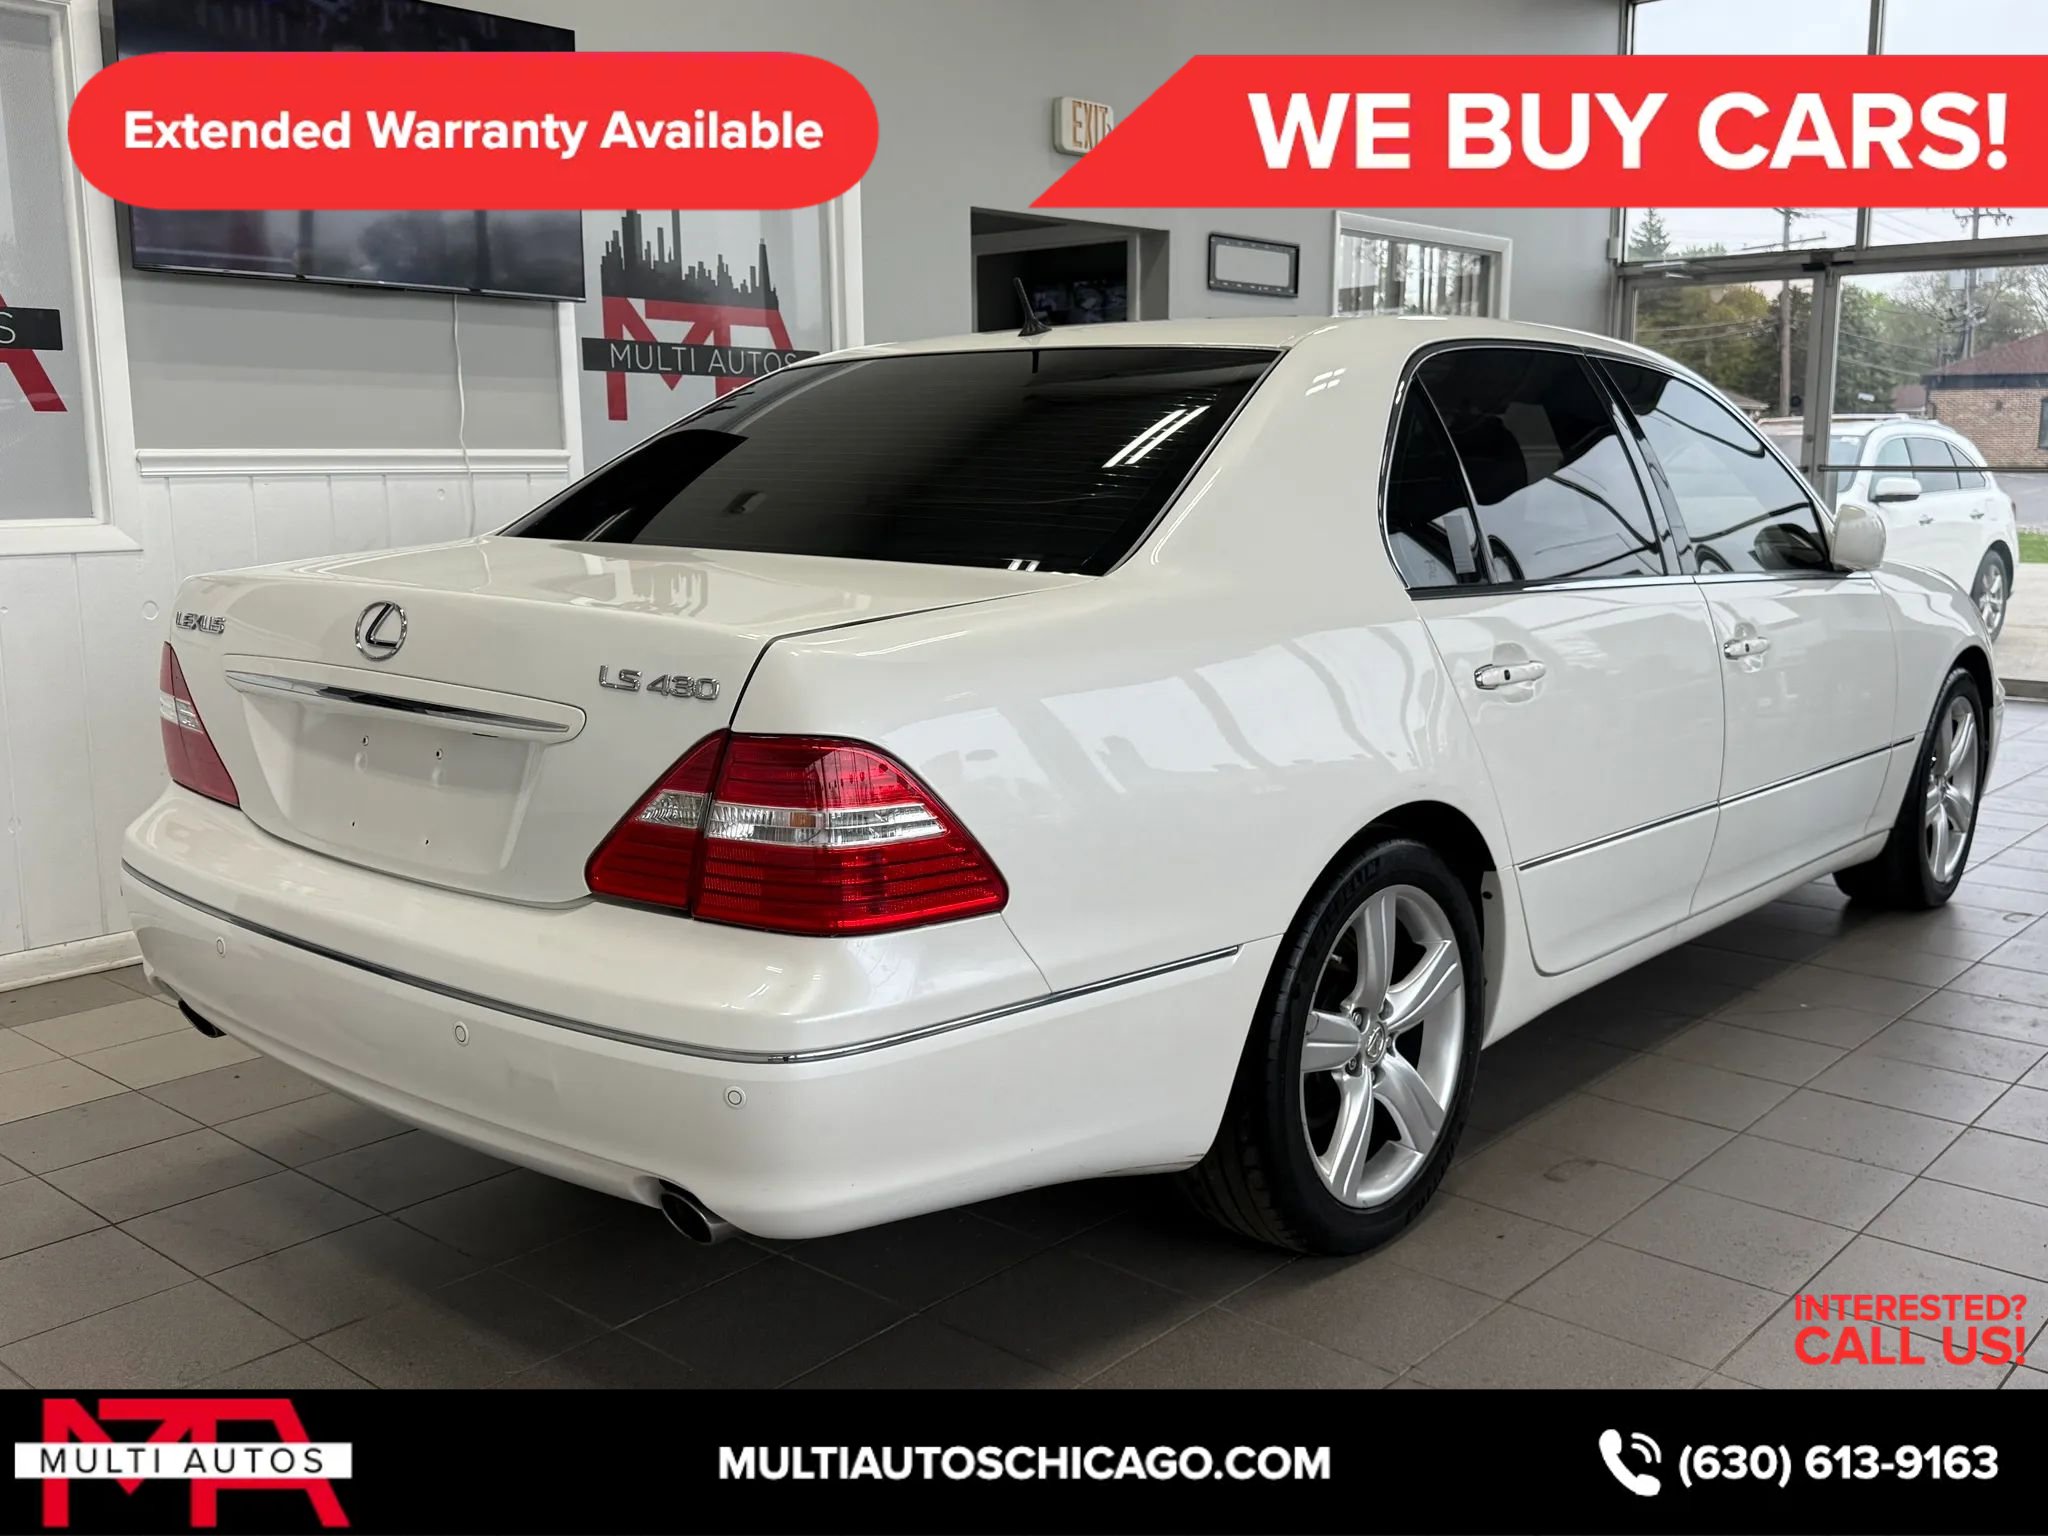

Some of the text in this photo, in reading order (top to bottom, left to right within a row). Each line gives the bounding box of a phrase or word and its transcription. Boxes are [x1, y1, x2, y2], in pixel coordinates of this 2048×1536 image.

[1072, 100, 1108, 149] EXIT
[610, 343, 798, 376] MULTI AUTOS
[176, 611, 226, 634] LEXUS
[599, 664, 721, 701] LS 430
